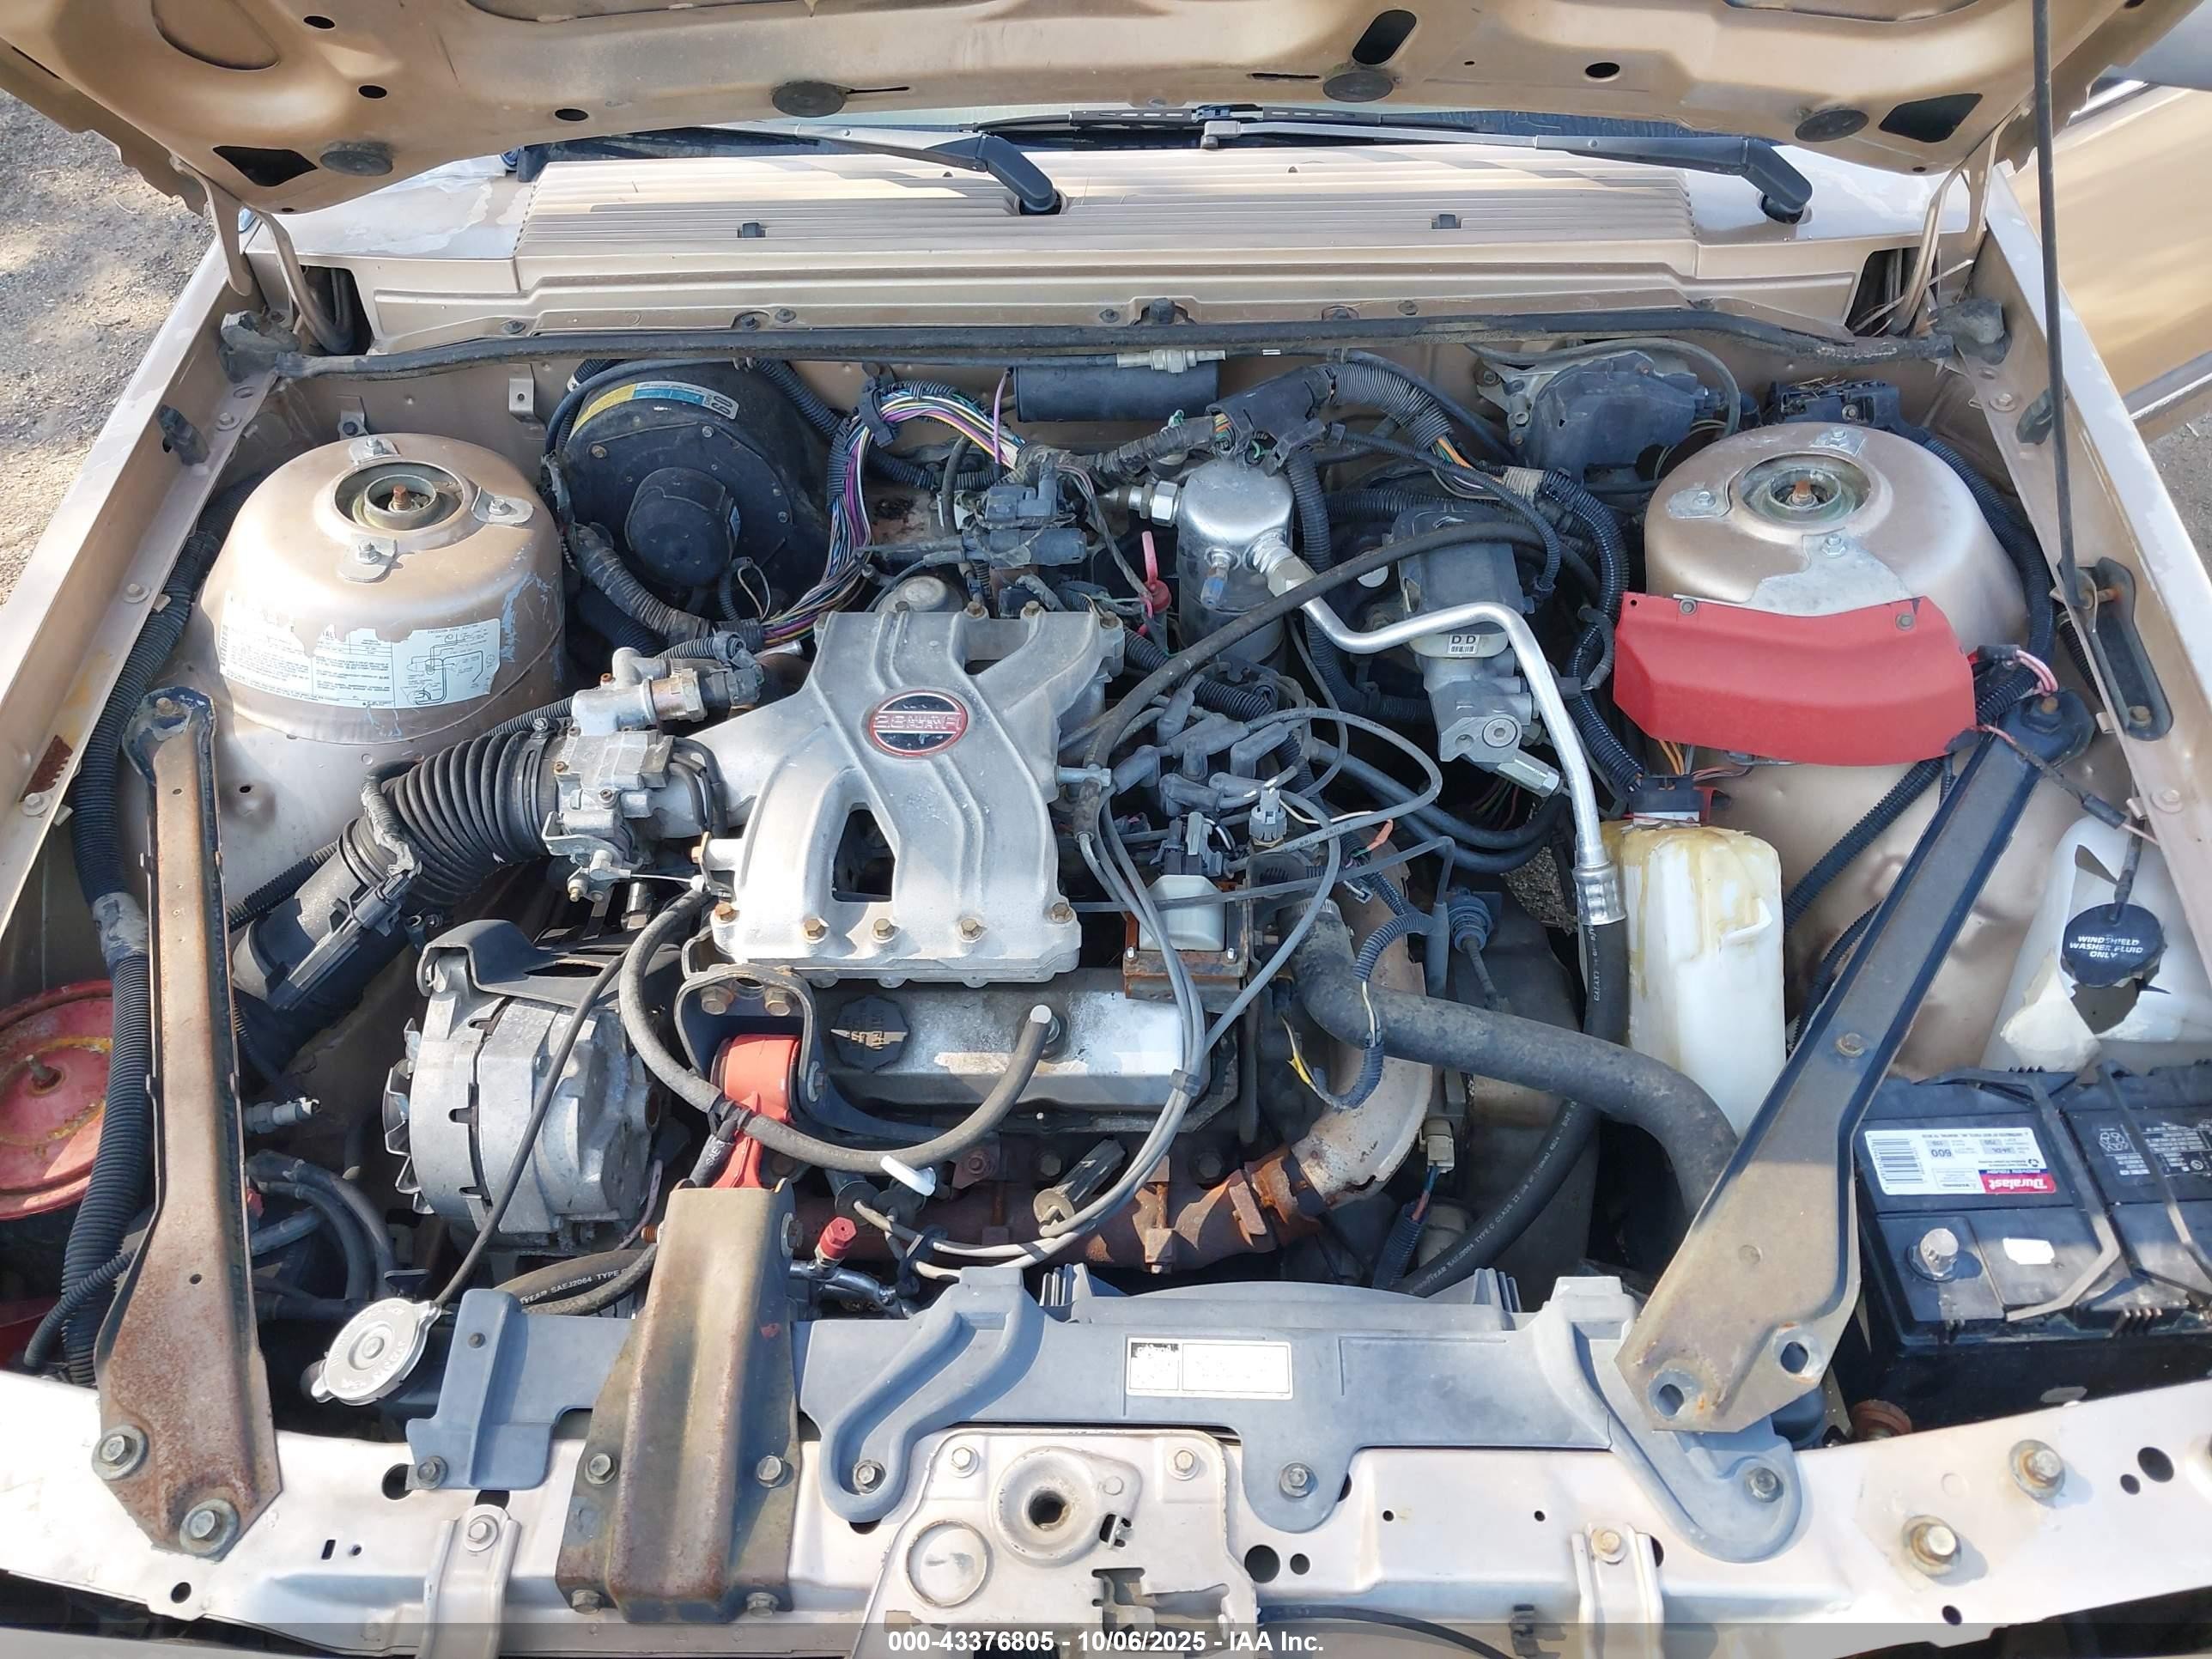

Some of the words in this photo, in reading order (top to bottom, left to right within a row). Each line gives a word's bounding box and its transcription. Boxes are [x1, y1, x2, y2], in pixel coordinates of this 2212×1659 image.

[2077, 935, 2140, 945] WINDSHIELD
[2069, 942, 2112, 951] WASHER
[2113, 945, 2143, 954] FLUID
[2089, 951, 2118, 959] ONLY
[1930, 1149, 1952, 1158] 600
[1989, 1179, 2048, 1190] Duralast
[550, 1276, 592, 1293] SAEJ2064
[596, 1269, 620, 1281] TYPE
